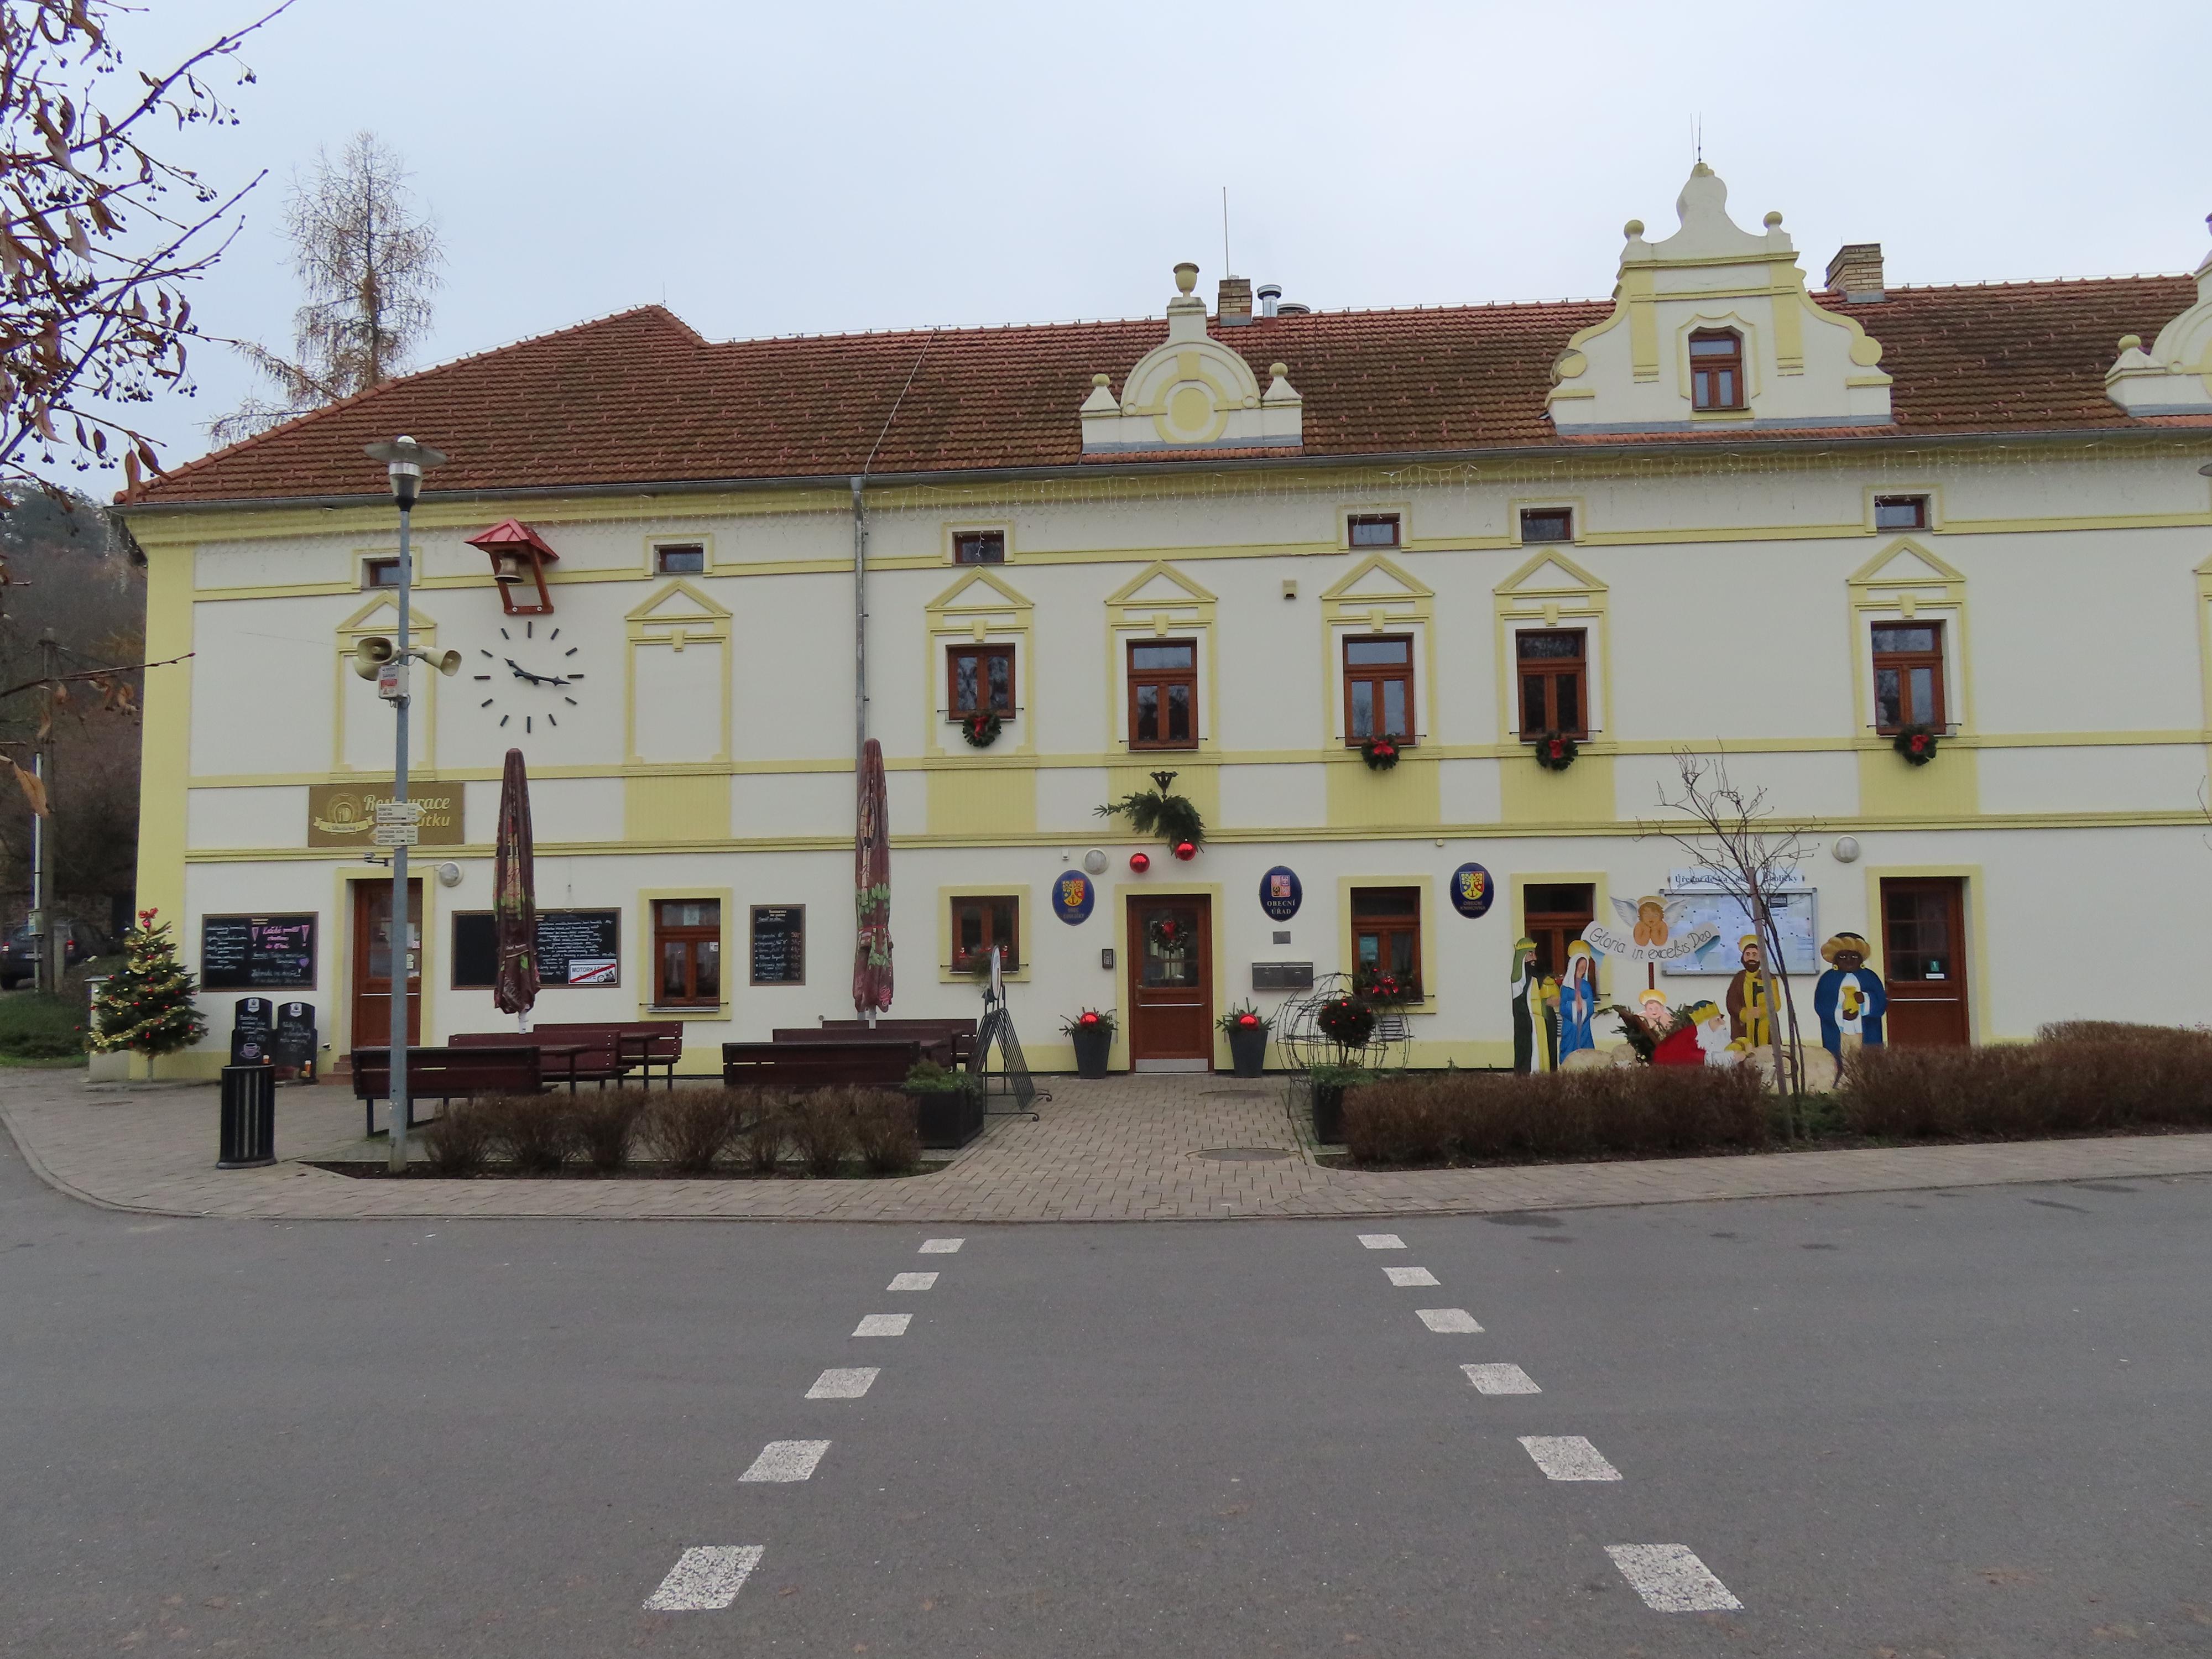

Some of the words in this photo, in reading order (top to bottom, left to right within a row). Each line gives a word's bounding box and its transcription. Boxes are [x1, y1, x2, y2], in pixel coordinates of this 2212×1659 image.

[1589, 927, 1625, 954] Gloria
[1631, 947, 1644, 960] in
[1647, 940, 1691, 959] excelsis
[1687, 930, 1712, 948] Deo
